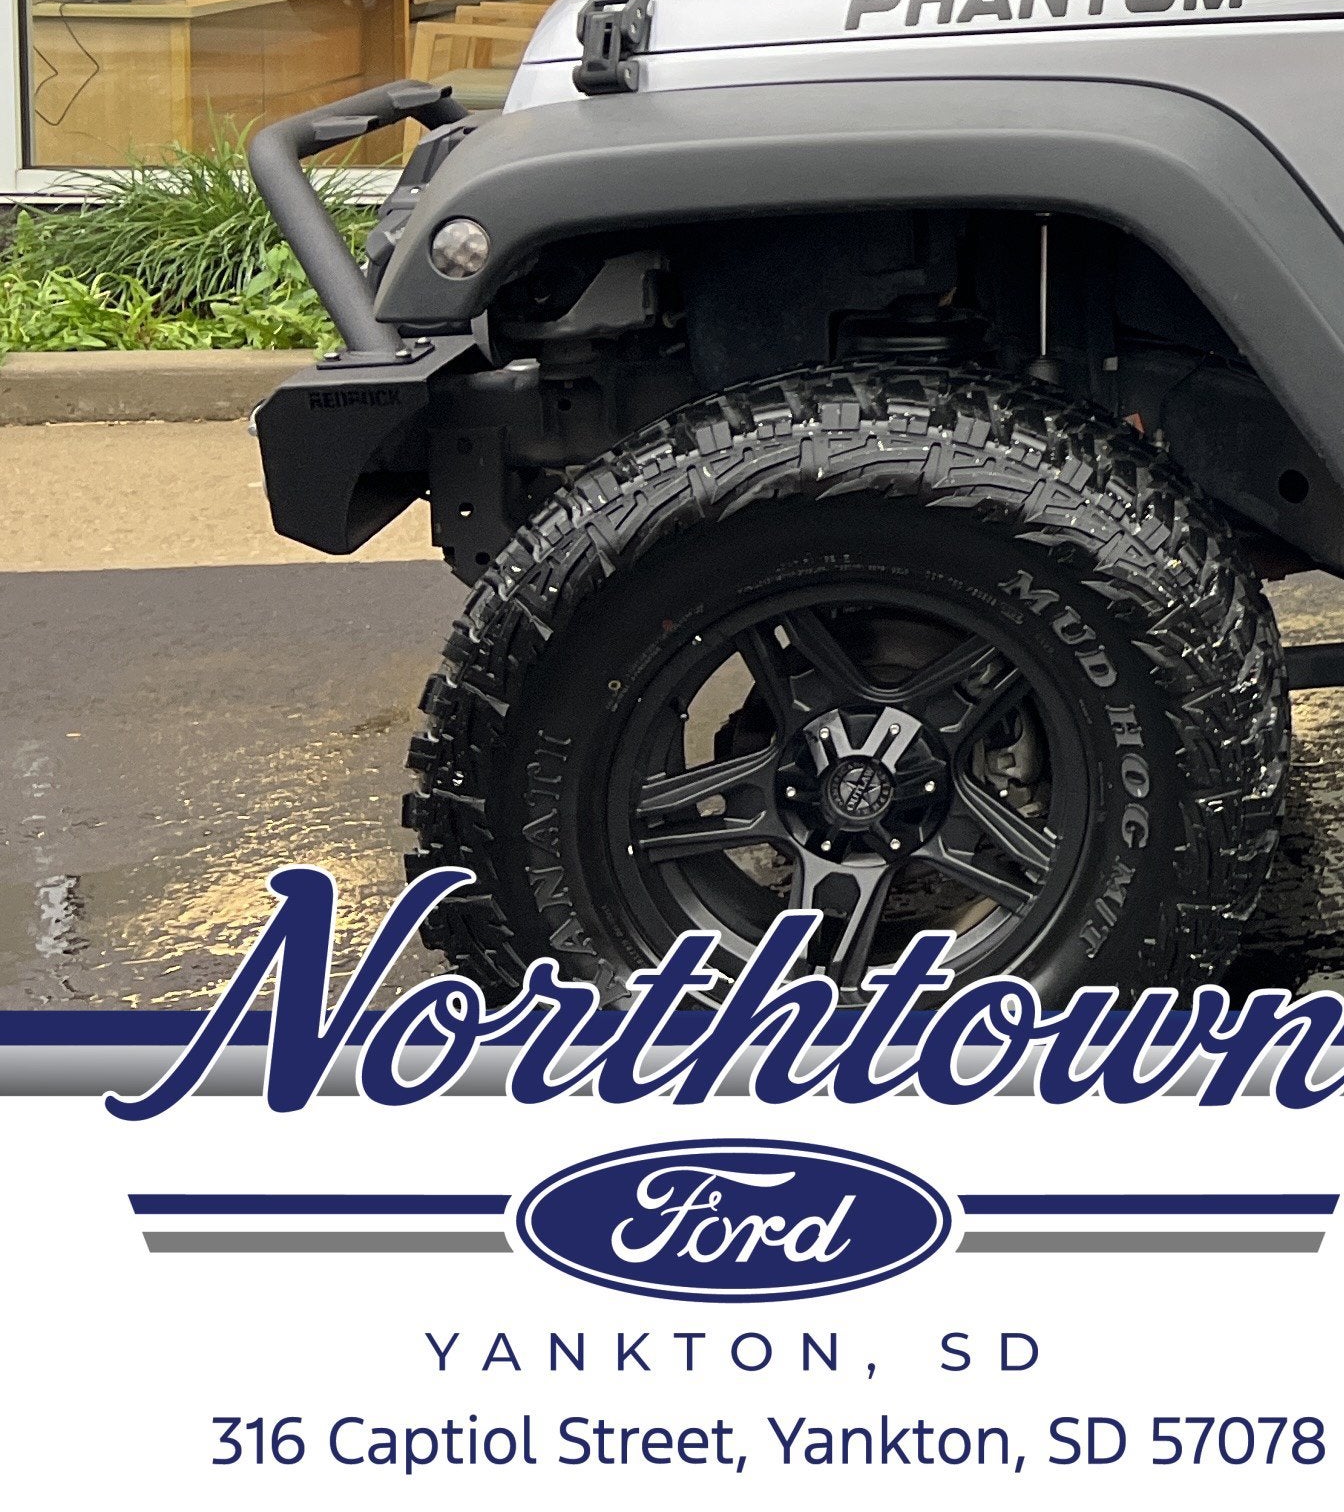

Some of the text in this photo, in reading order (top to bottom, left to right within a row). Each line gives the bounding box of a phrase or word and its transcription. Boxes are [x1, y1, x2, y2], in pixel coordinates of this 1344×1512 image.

[997, 569, 1151, 959] MUD HOG M/T
